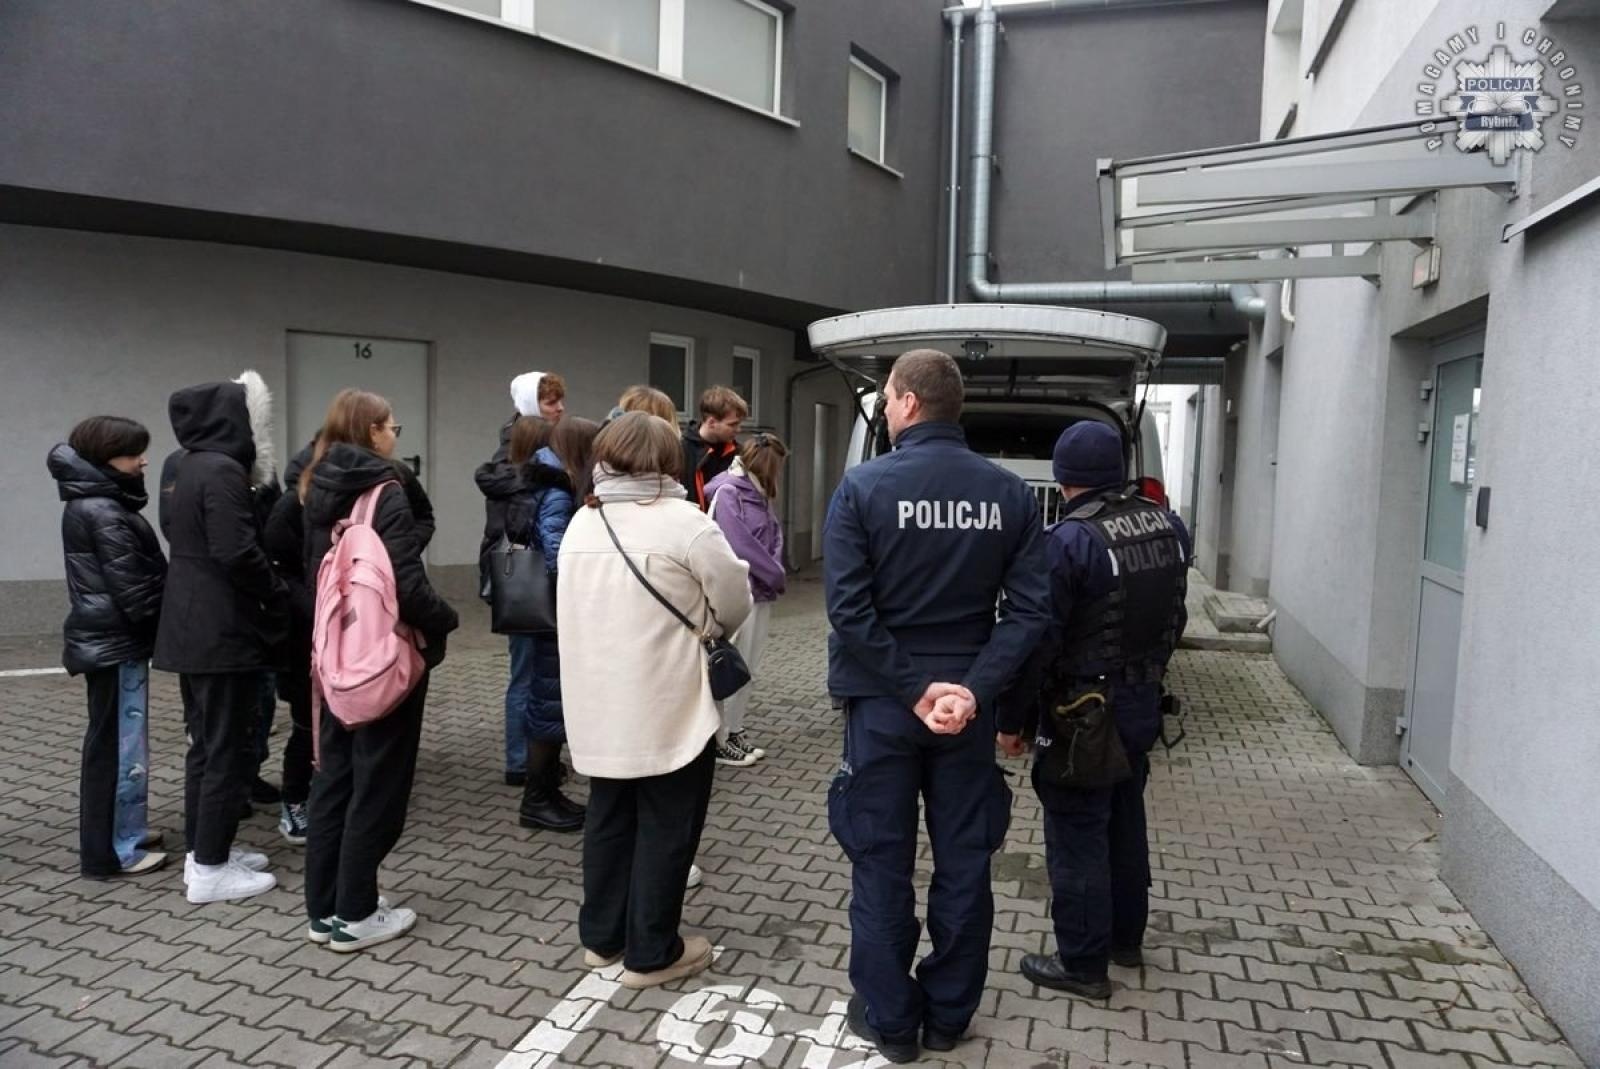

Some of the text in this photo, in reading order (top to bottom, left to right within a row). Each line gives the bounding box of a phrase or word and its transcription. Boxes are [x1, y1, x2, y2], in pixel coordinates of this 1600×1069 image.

[354, 341, 372, 359] 16
[897, 500, 1002, 531] POLICJA
[1102, 511, 1173, 541] POLICJA
